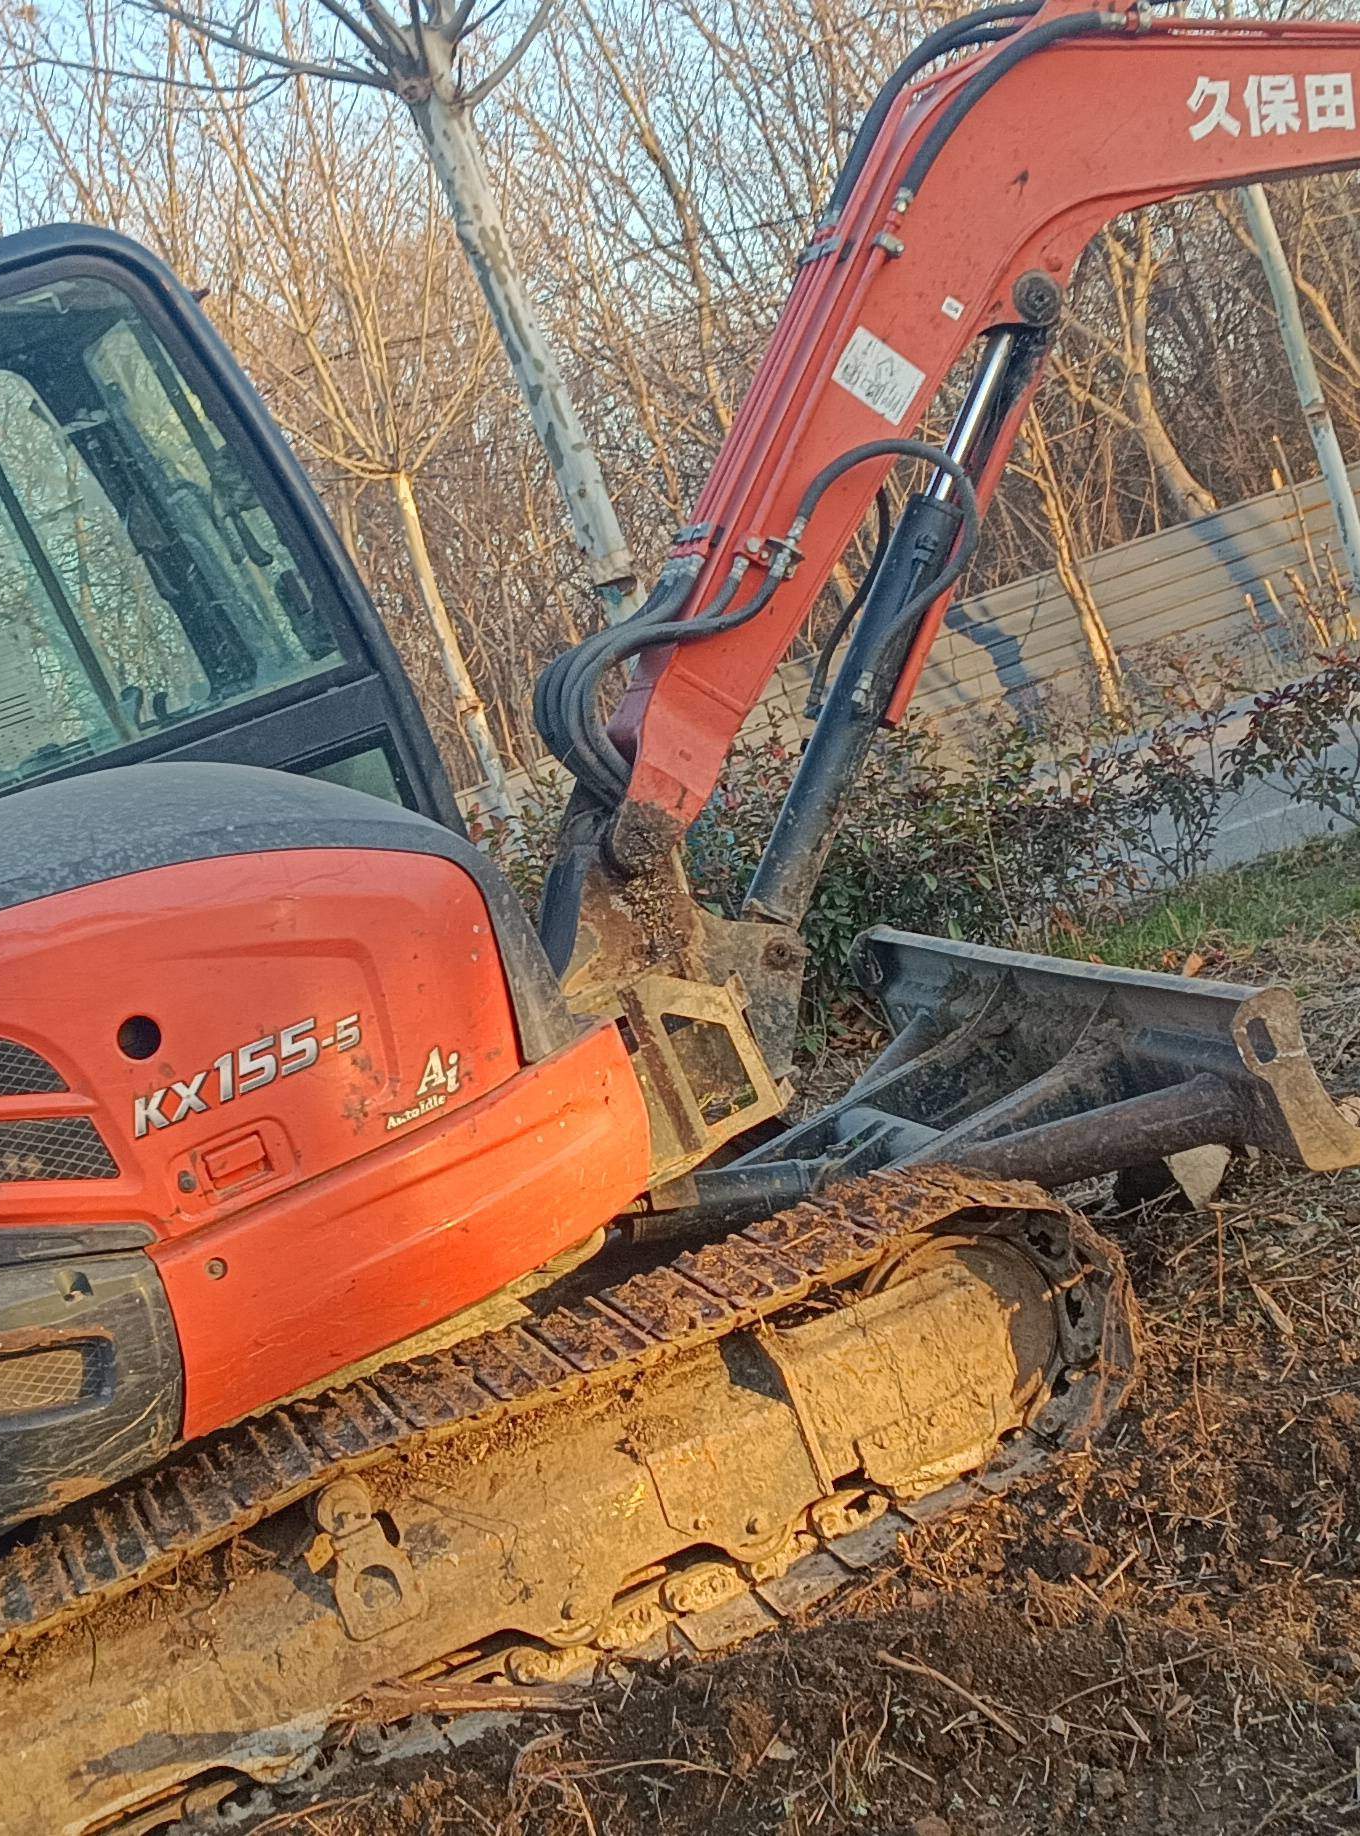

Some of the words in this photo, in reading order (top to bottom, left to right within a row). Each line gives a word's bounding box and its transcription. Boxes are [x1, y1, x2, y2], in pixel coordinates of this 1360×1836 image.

[1186, 73, 1356, 141] 久保田
[134, 1013, 361, 1138] KX155-5
[416, 1046, 460, 1096] Ai
